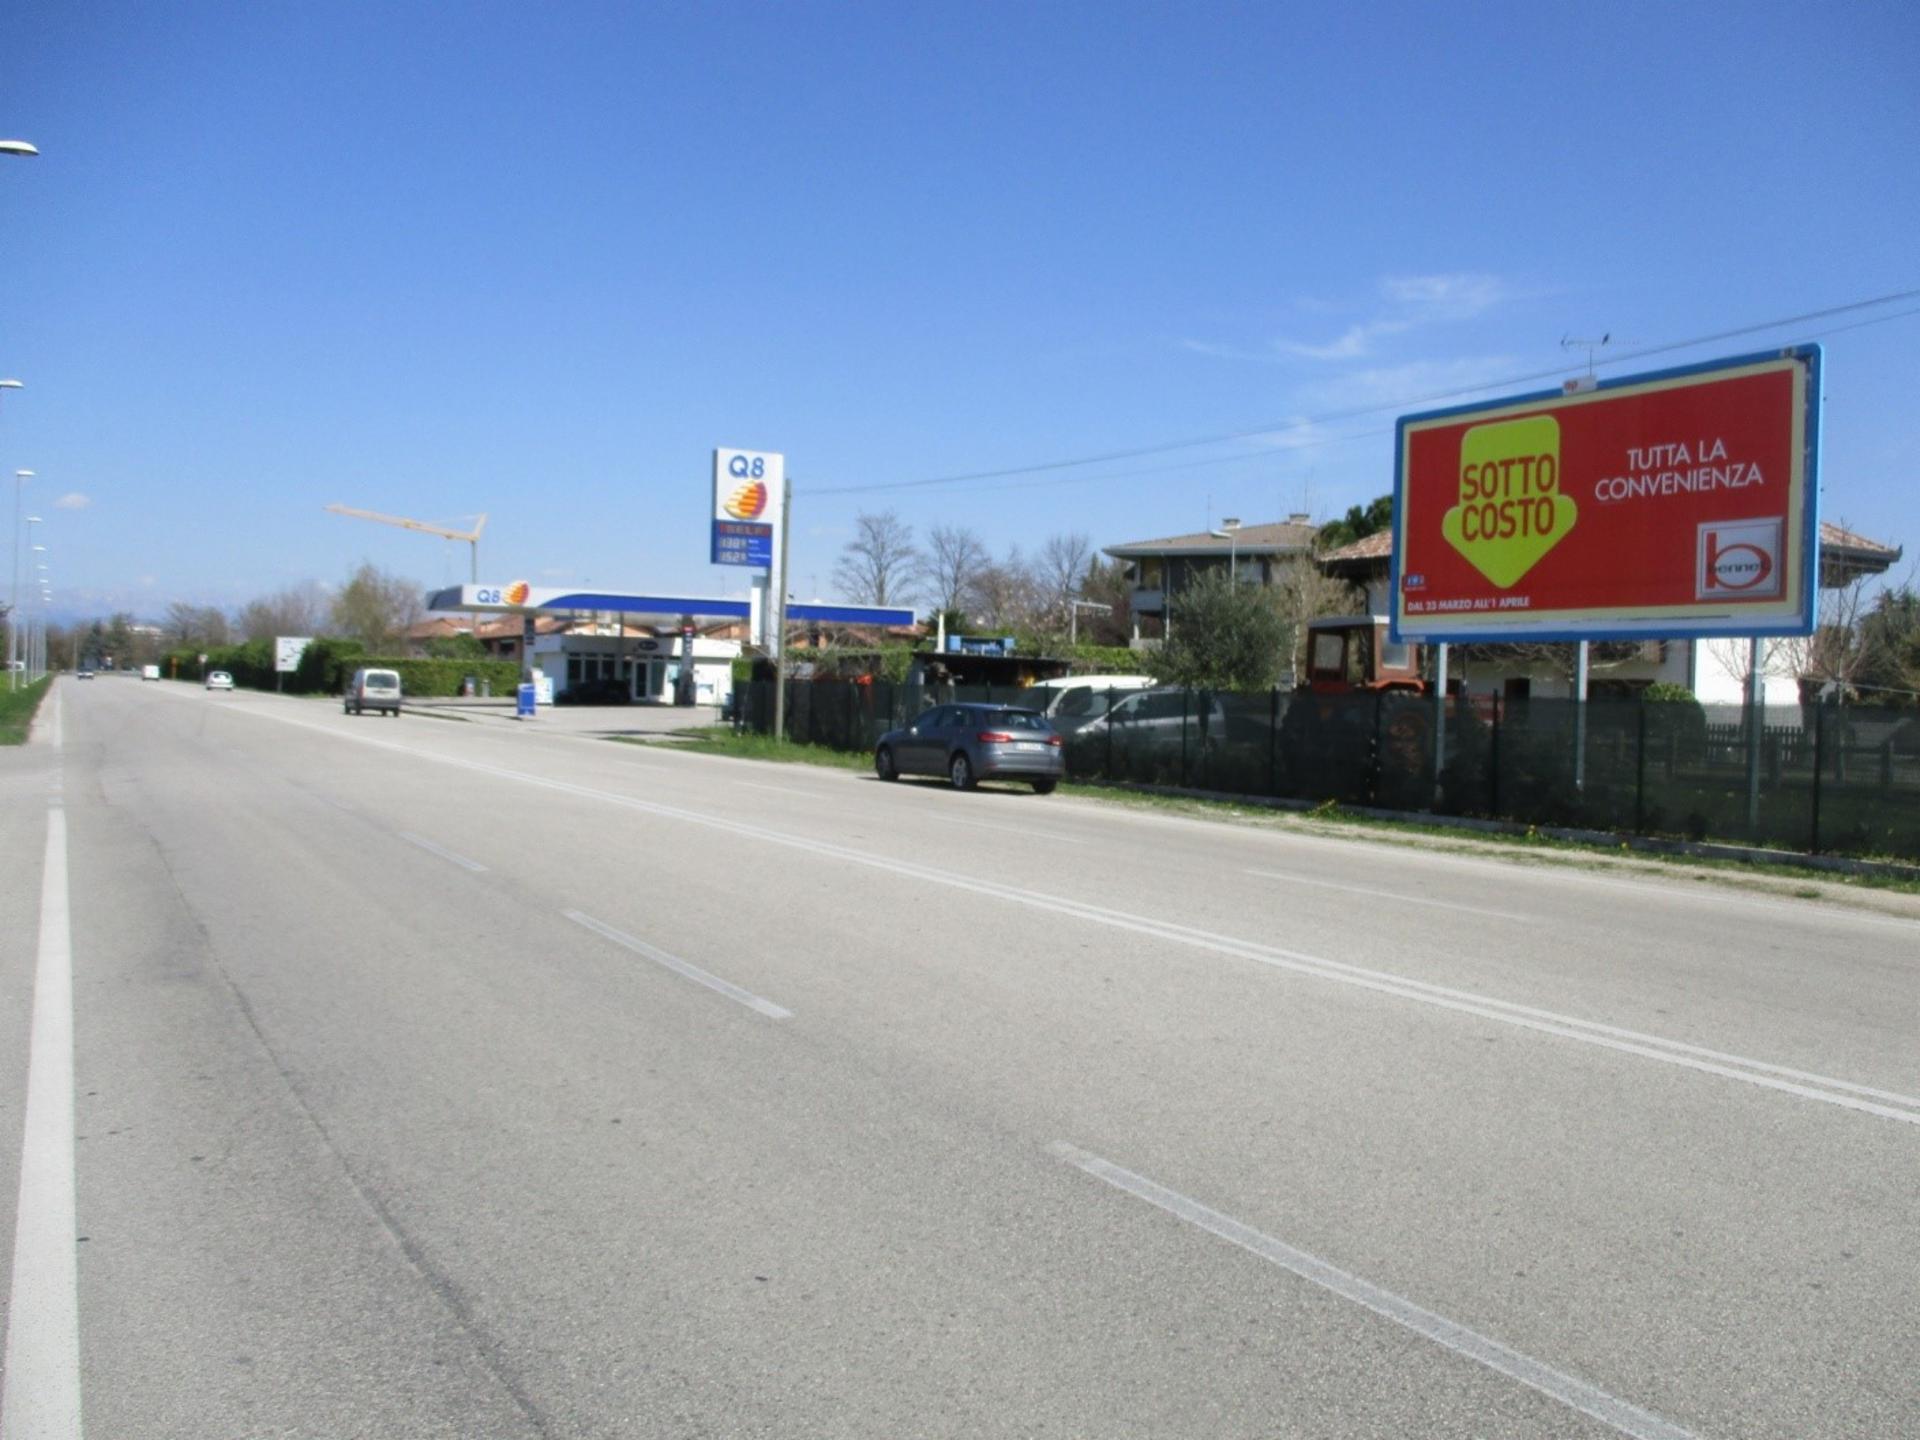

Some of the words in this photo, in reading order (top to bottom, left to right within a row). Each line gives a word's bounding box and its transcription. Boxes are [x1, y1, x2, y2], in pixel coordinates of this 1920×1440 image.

[728, 455, 765, 479] Q8
[1627, 443, 1691, 471] TUTTA
[1699, 437, 1727, 463] LA
[1462, 453, 1555, 502] SOTTO
[1594, 461, 1764, 501] CONVENIENZA
[1462, 496, 1555, 542] COSTO
[477, 589, 500, 604] Q8
[1407, 601, 1424, 612] DAL
[1438, 599, 1472, 610] MARZO
[1498, 596, 1531, 608] APRILE
